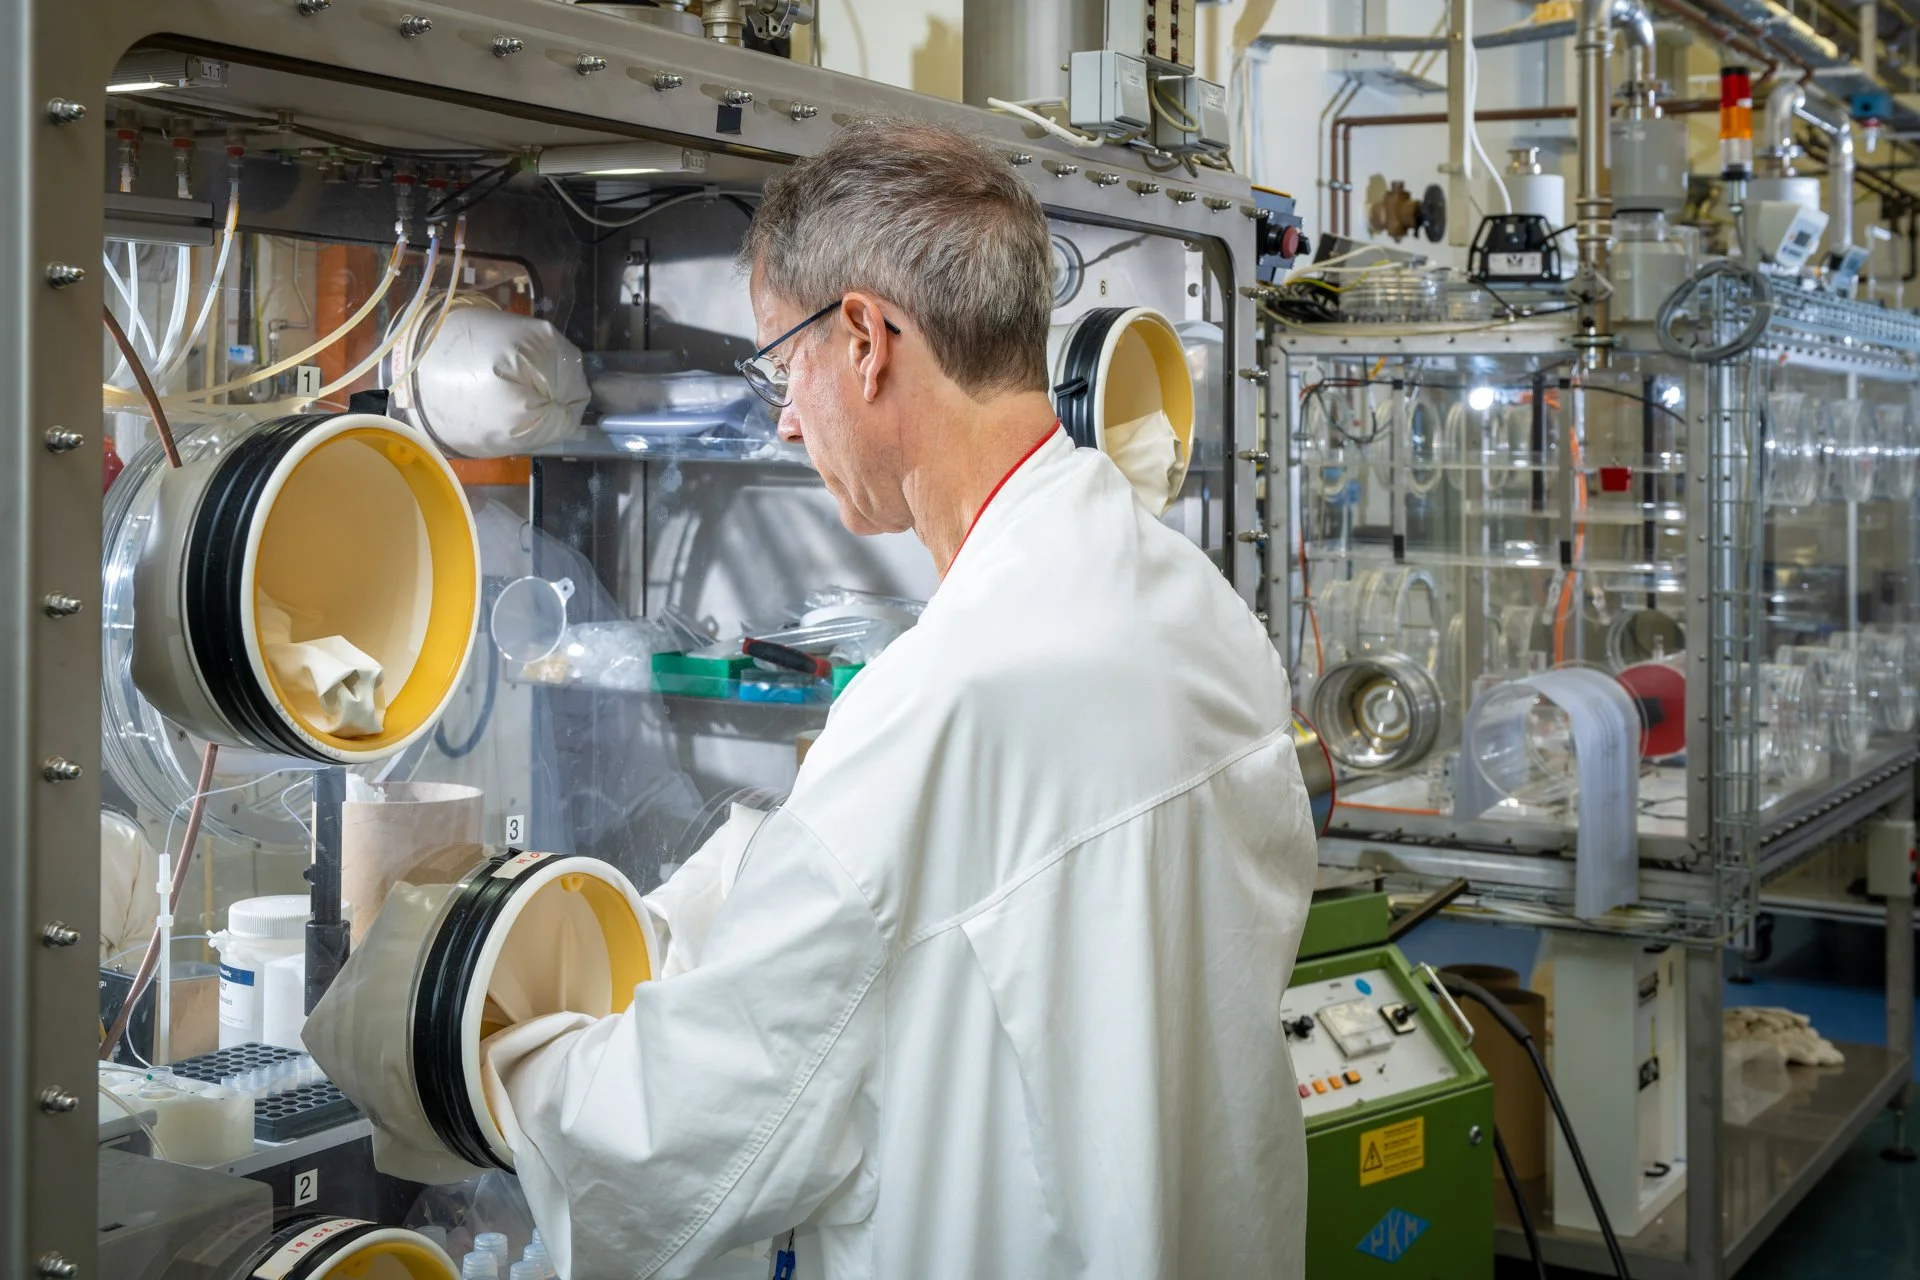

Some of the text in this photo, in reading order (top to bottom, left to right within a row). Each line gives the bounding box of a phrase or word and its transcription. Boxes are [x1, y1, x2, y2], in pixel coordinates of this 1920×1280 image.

[201, 63, 220, 78] L1.1
[1100, 280, 1106, 295] 6
[304, 370, 310, 393] 1
[509, 819, 519, 840] 3
[299, 1175, 311, 1200] 2
[1370, 1210, 1419, 1260] PKM
